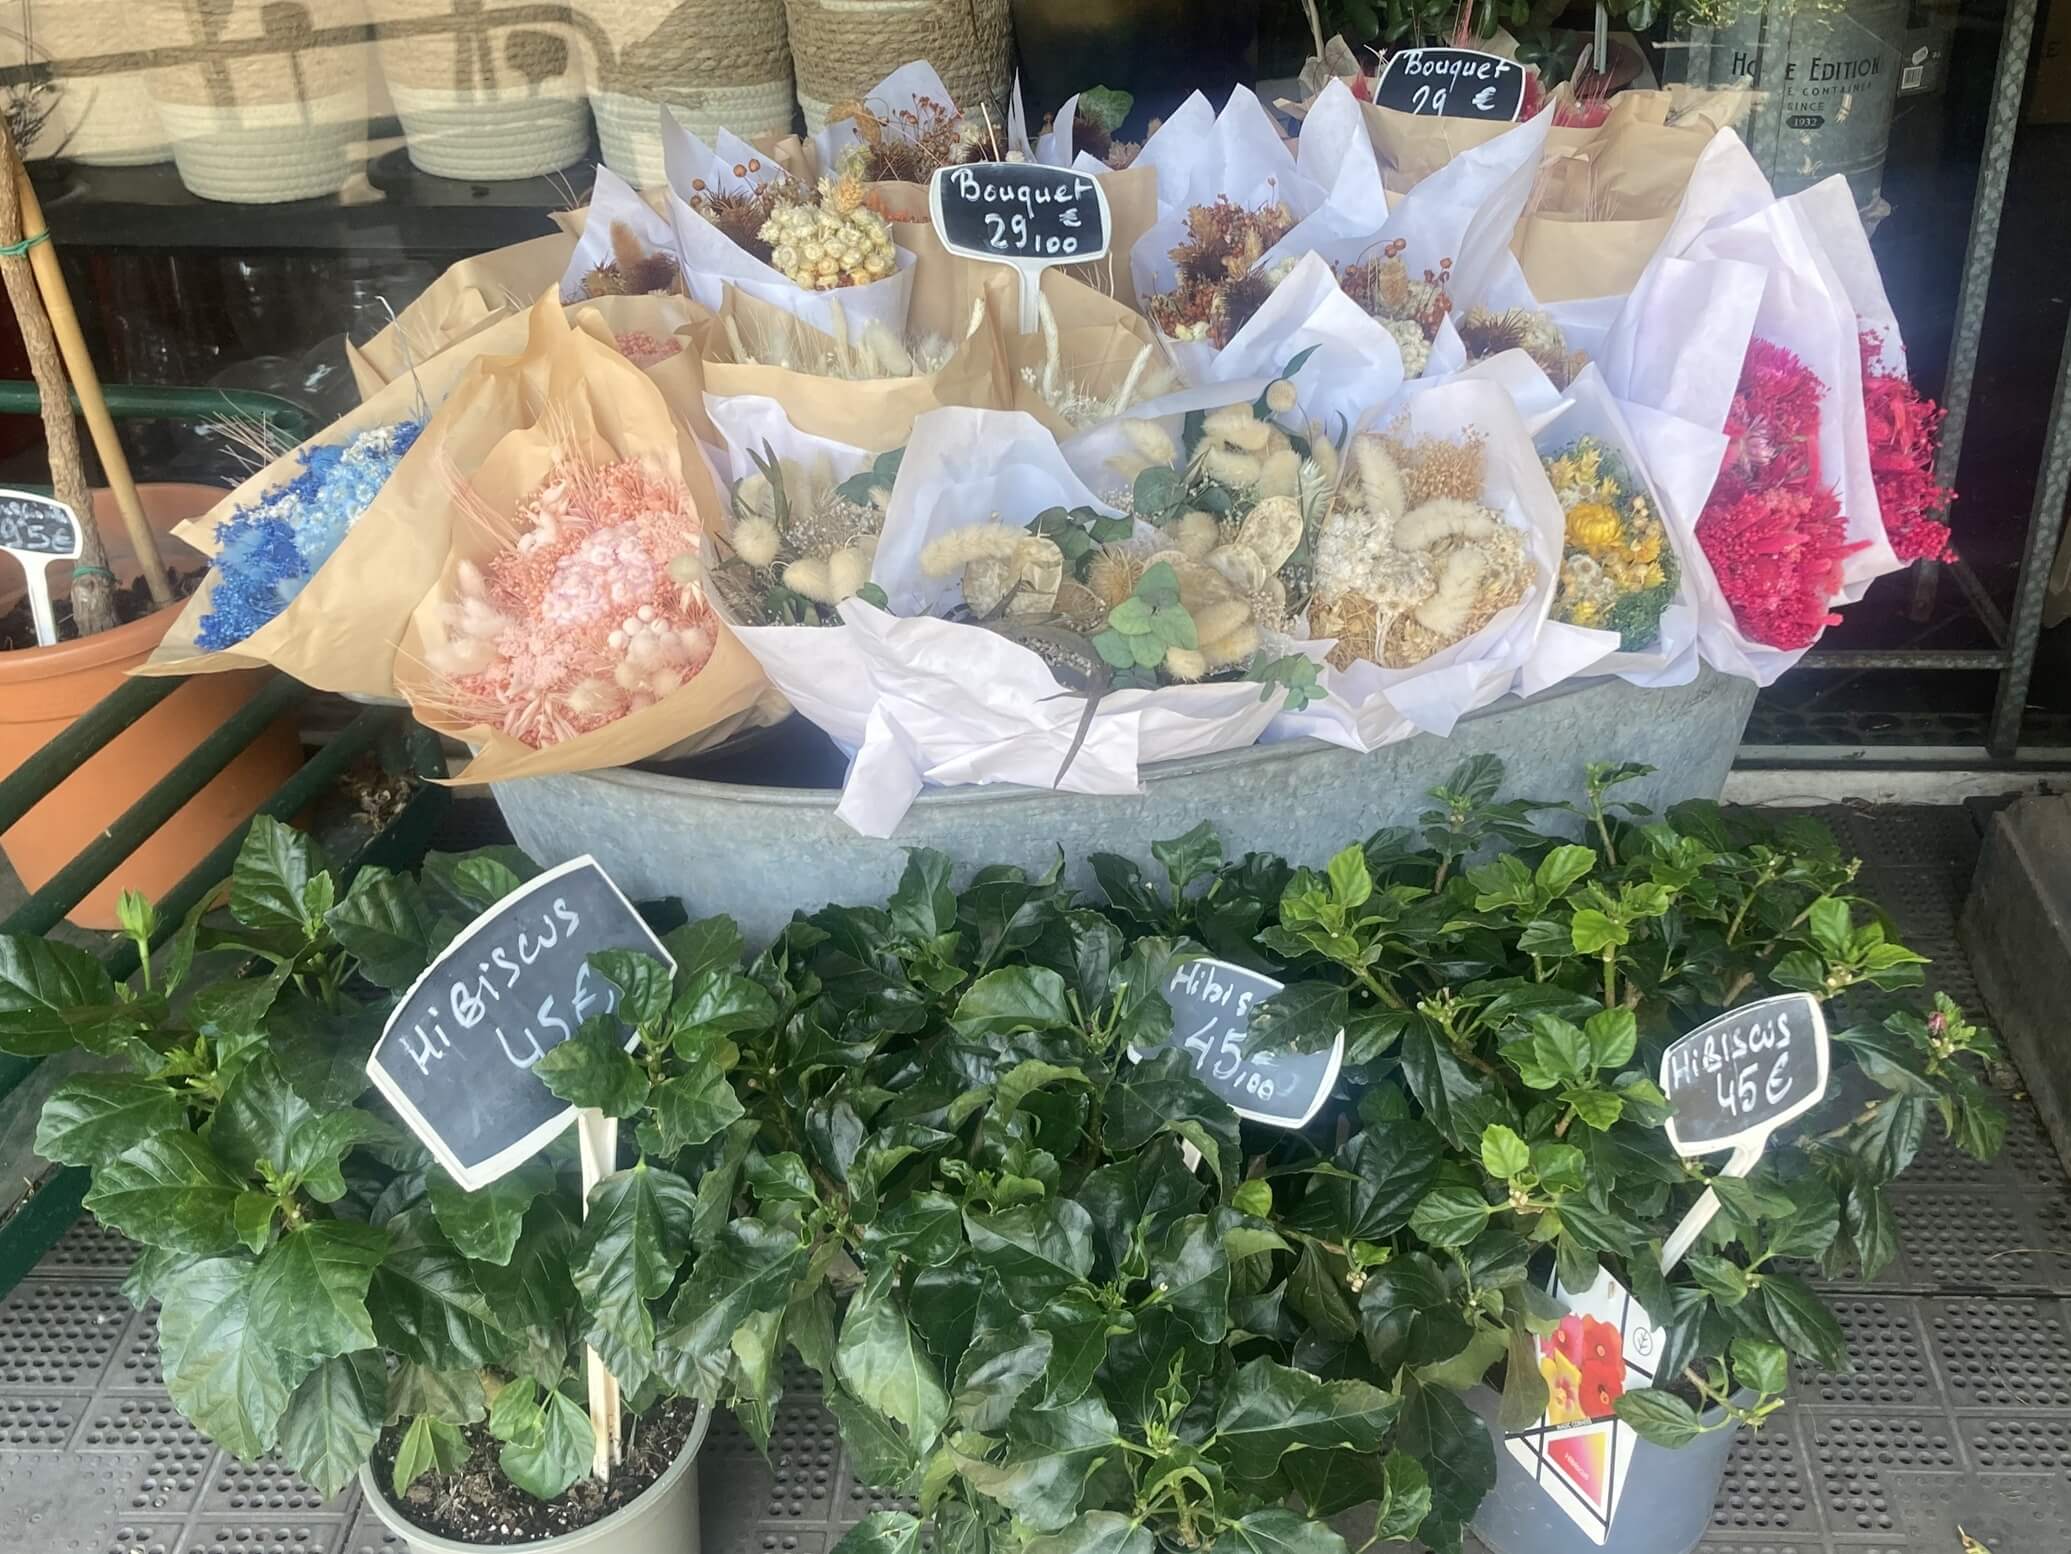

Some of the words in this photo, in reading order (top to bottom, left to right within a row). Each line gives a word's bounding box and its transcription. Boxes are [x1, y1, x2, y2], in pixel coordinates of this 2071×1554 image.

[1403, 50, 1511, 93] Bouquet
[1732, 51, 1797, 80] HOE
[1809, 56, 1880, 81] EDITION
[1472, 86, 1497, 111] €
[1787, 102, 1824, 112] SINCE
[1794, 118, 1817, 127] 1932
[951, 168, 1093, 219] Bouquet
[1169, 963, 1253, 1016] Hibis
